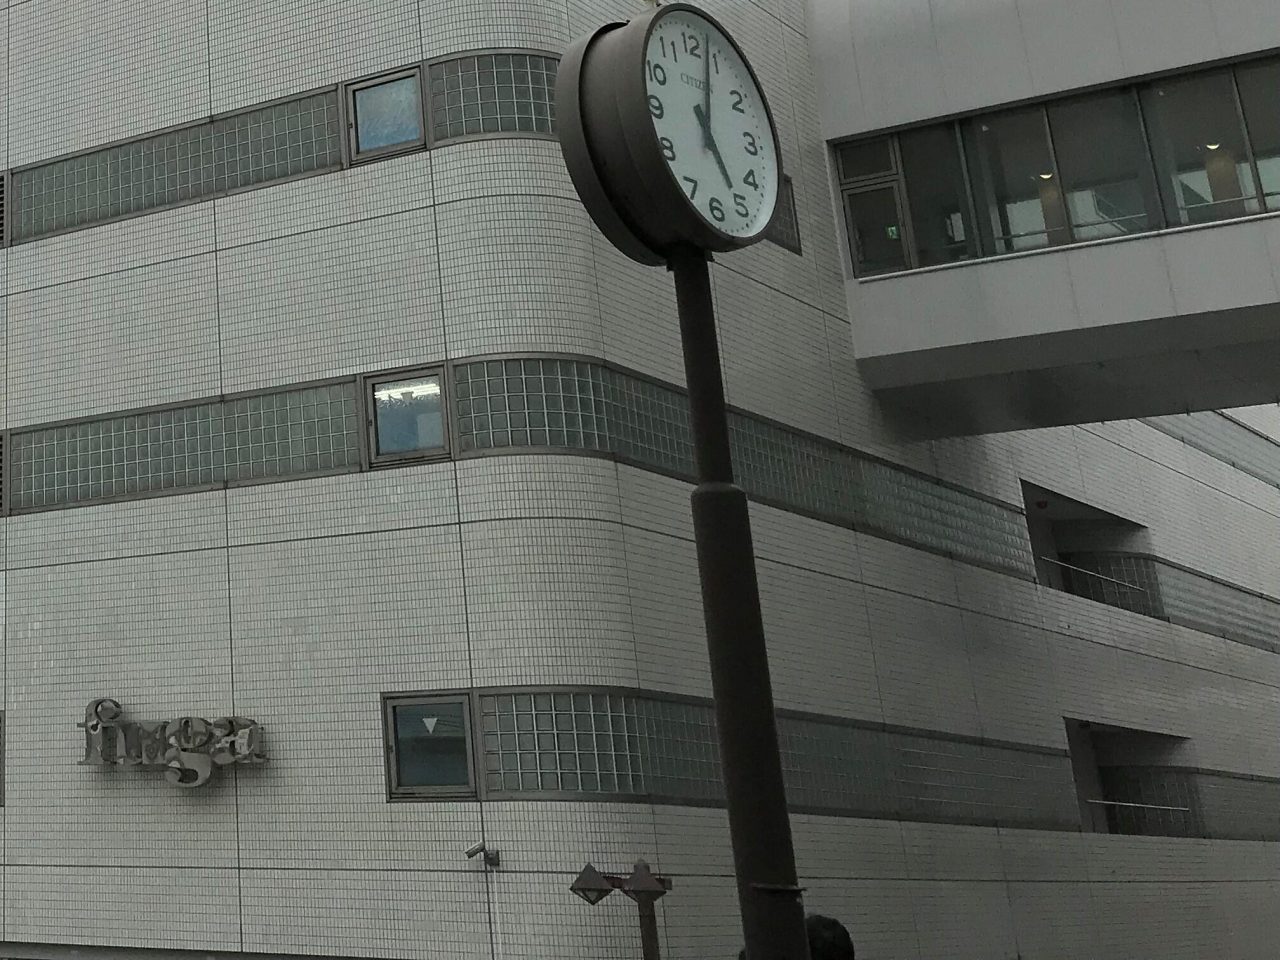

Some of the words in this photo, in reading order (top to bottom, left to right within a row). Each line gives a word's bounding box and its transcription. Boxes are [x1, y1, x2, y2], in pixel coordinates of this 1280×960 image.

[660, 36, 678, 63] 11
[681, 32, 702, 60] 12
[646, 60, 667, 86] 10
[712, 52, 719, 74] 1
[648, 94, 664, 119] 9
[729, 90, 745, 114] 2
[659, 137, 676, 162] 8
[742, 132, 758, 156] 3
[683, 176, 698, 200] 7
[743, 169, 759, 191] 4
[708, 197, 725, 222] 6
[733, 193, 749, 218] 5
